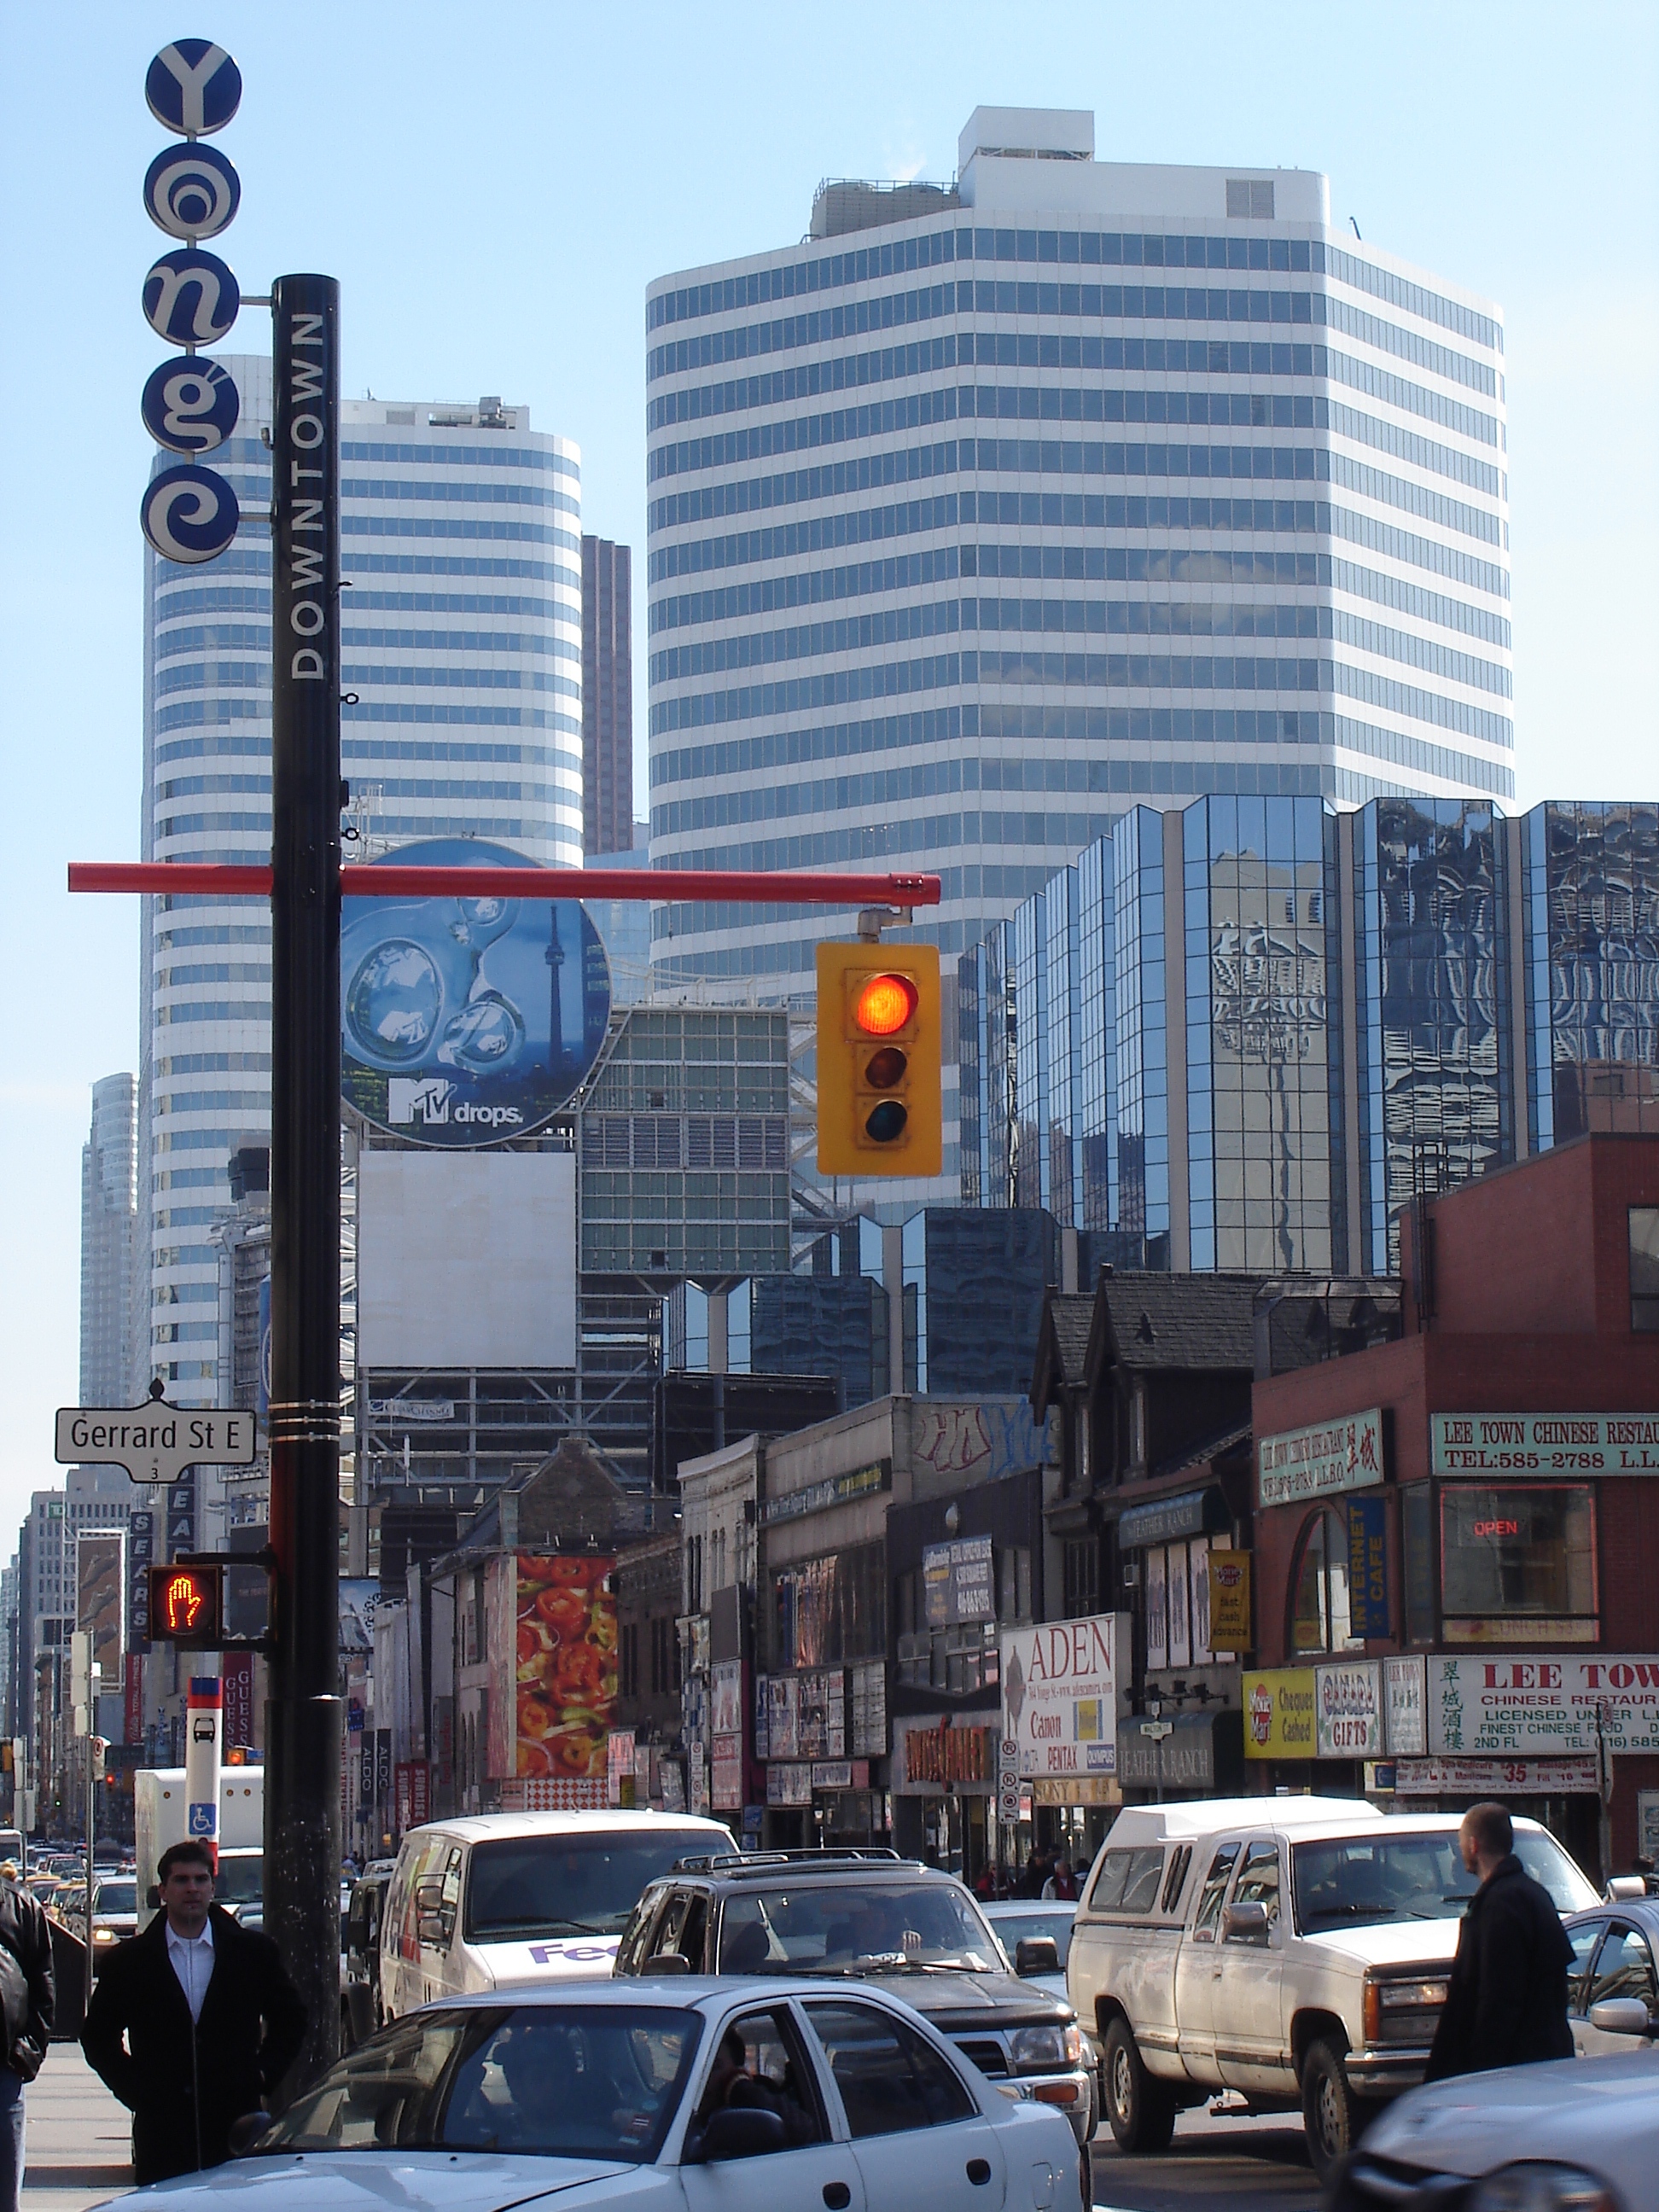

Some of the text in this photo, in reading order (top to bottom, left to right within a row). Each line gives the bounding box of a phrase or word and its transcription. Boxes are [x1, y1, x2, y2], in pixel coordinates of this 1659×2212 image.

[291, 313, 325, 680] DOWNTOWN
[388, 1078, 523, 1127] MTV drops.
[72, 1420, 240, 1450] Gerrard St E
[1444, 1421, 1474, 1444] LEE
[1480, 1421, 1525, 1444] TOWN
[1533, 1421, 1598, 1444] CHINESE
[1444, 1450, 1604, 1469] TEL:585-2788
[151, 1468, 159, 1481] 3
[1474, 1519, 1517, 1536] OPEN
[1350, 1506, 1366, 1631] INTERNET
[1369, 1537, 1384, 1602] CAFE
[1028, 1620, 1113, 1681] ADEN
[1481, 1663, 1659, 1689] LEE TOW
[238, 1671, 249, 1746] GUESS
[1278, 1685, 1313, 1717] Cheques
[1323, 1674, 1376, 1715] CANADA
[1481, 1695, 1562, 1705] CHINESE
[225, 1677, 237, 1750] GUESS
[1030, 1710, 1062, 1739] Canon
[1486, 1709, 1567, 1720] LICENSED
[1576, 1709, 1632, 1720] UNER
[1282, 1717, 1312, 1743] Cashed
[1333, 1720, 1367, 1747] GIFTS
[1474, 1737, 1500, 1749] 2ND
[1504, 1738, 1519, 1748] FL
[1563, 1737, 1590, 1748] TEL:
[1594, 1737, 1627, 1749] (16)
[1480, 1723, 1523, 1734] FINEST
[1527, 1723, 1580, 1734] CHINESE
[1586, 1723, 1623, 1734] FOD
[362, 1748, 372, 1791] ALDO
[1047, 1745, 1078, 1772] PENTAX
[1086, 1749, 1114, 1766] OLYMPUS
[1170, 1749, 1208, 1784] RANCH
